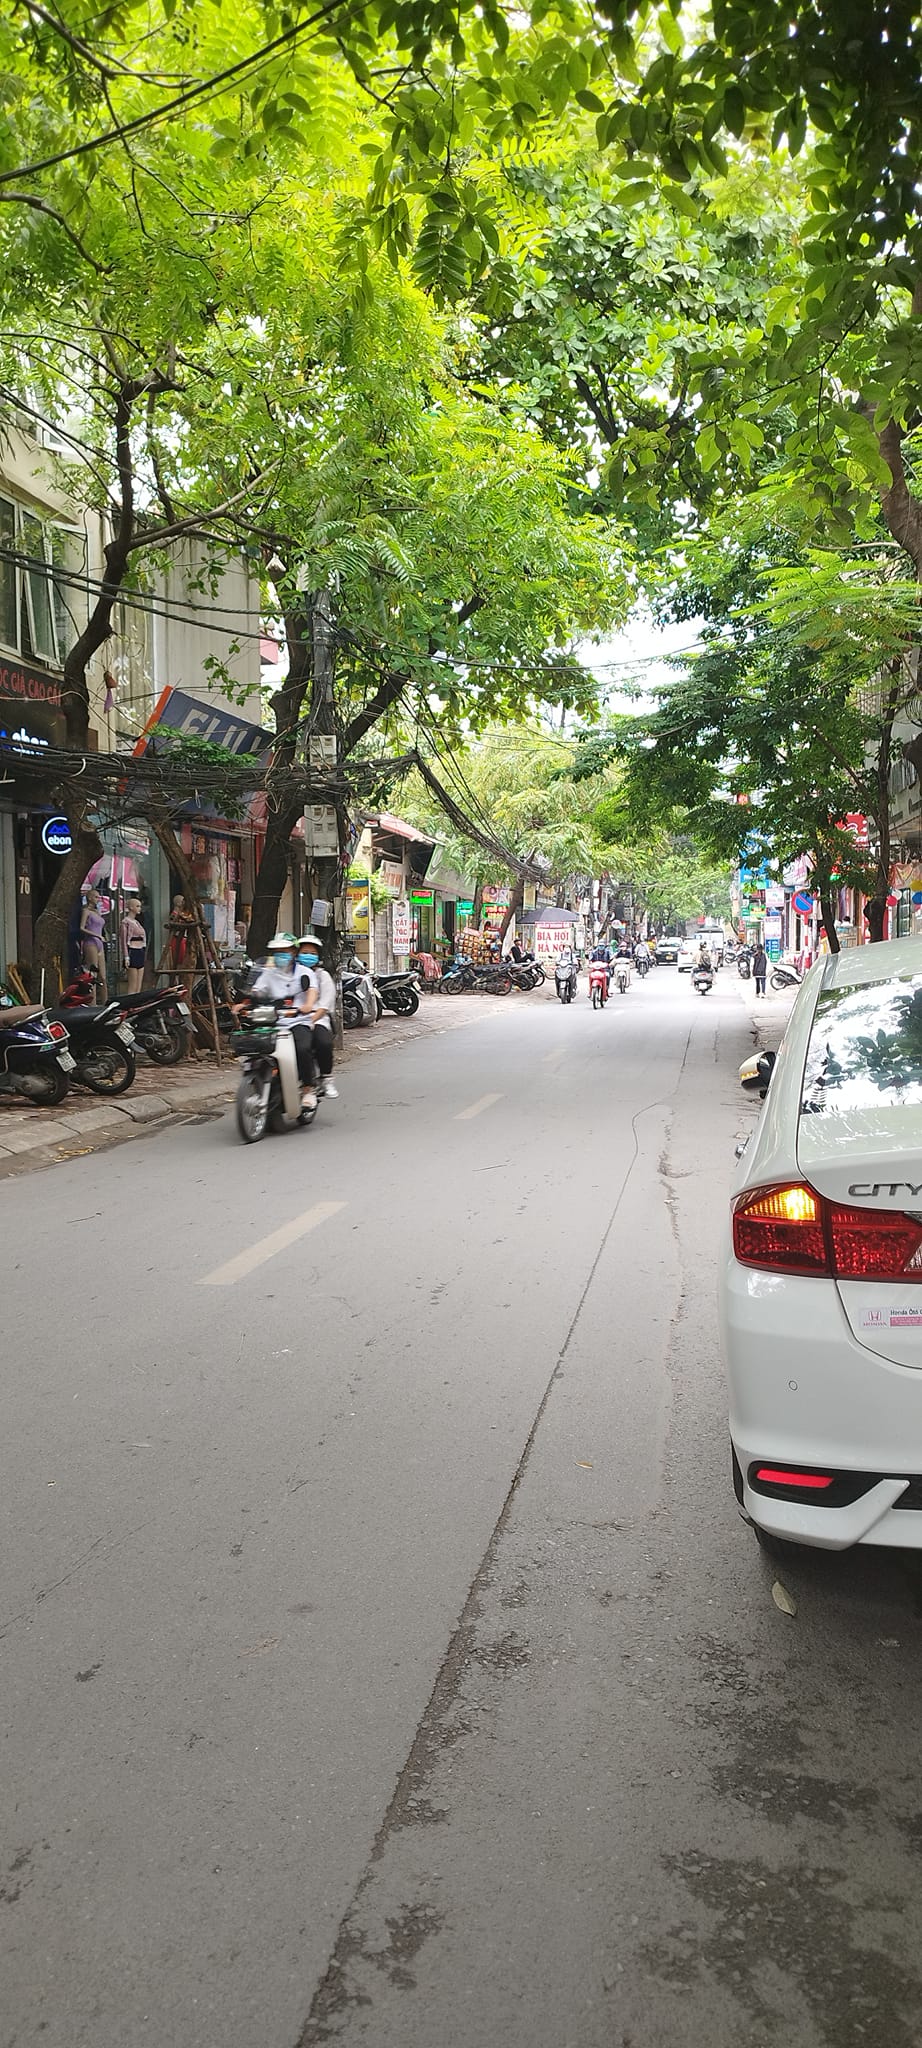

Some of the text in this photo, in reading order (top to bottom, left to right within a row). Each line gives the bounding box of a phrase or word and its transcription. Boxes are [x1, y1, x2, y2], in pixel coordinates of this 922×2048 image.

[29, 679, 45, 699] CAO
[48, 835, 71, 845] ebon
[19, 876, 31, 895] 76
[537, 932, 551, 940] BIA
[848, 1183, 922, 1196] CITY
